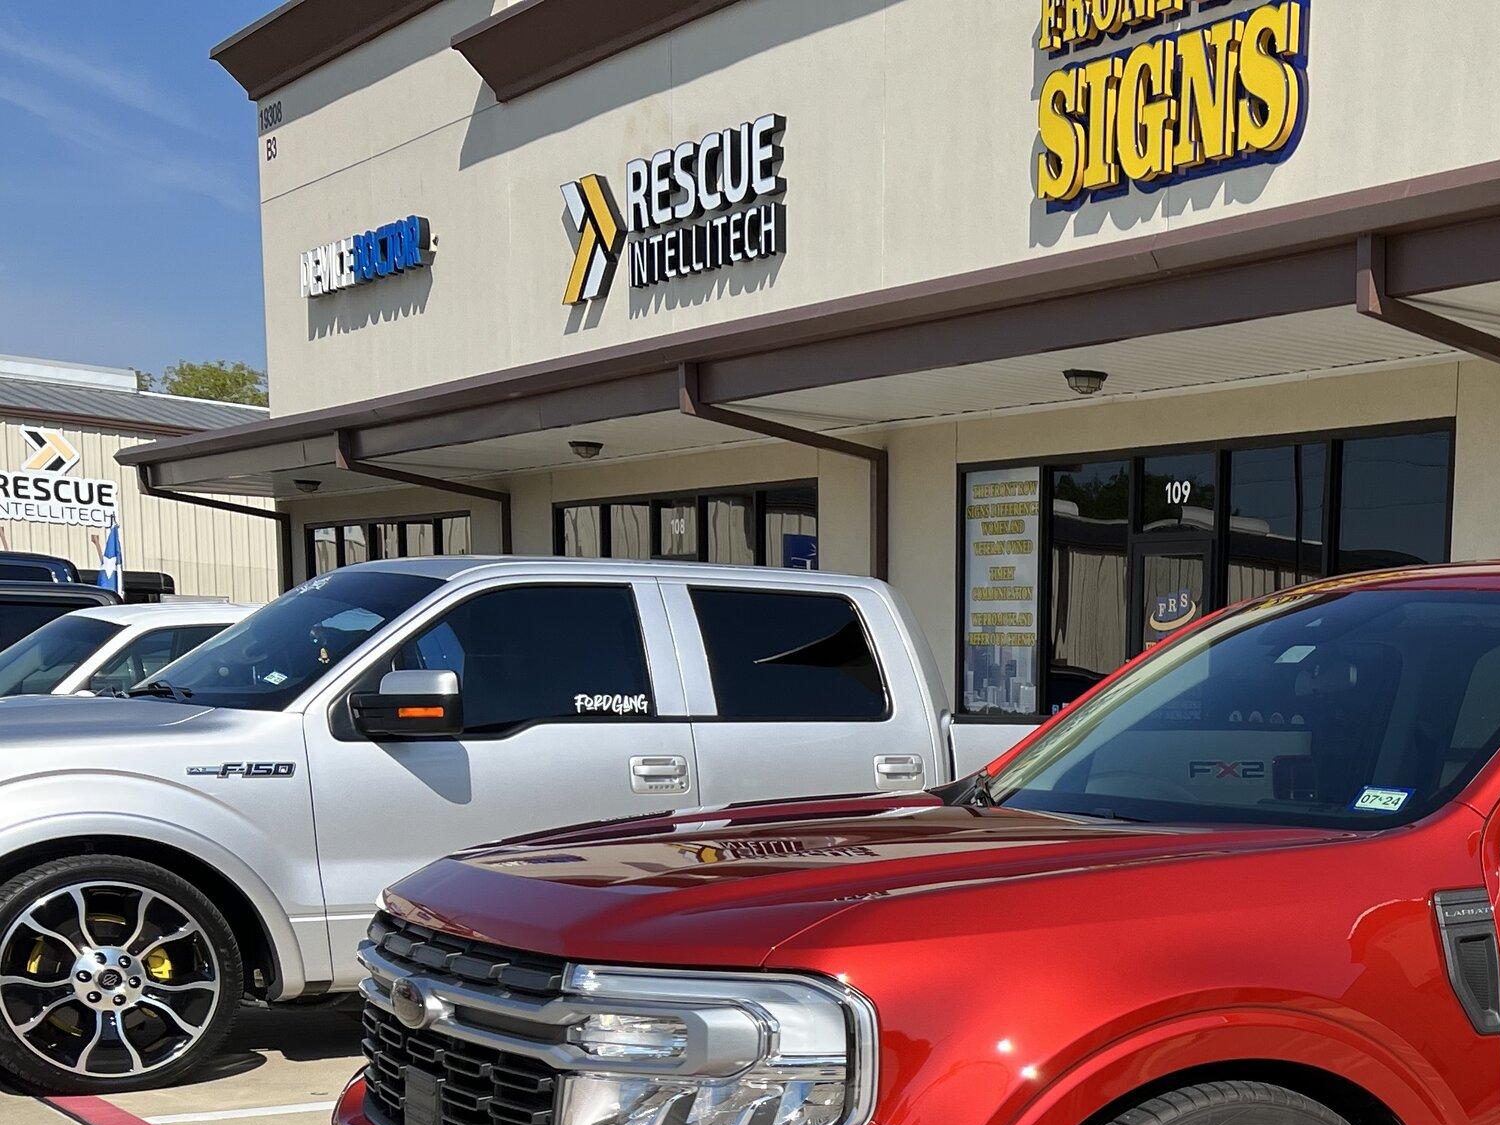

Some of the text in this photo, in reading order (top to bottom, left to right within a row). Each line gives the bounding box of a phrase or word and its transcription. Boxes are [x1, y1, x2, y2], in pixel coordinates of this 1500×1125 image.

[1037, 2, 1302, 200] SIGNS
[266, 136, 277, 161] B3
[626, 113, 779, 232] RESCUE
[628, 202, 779, 288] INTELLITECH
[1165, 480, 1191, 504] 109
[0, 501, 116, 524] NTELLITECH
[670, 518, 686, 535] 108
[221, 762, 296, 777] F-150
[1189, 761, 1265, 779] FX2
